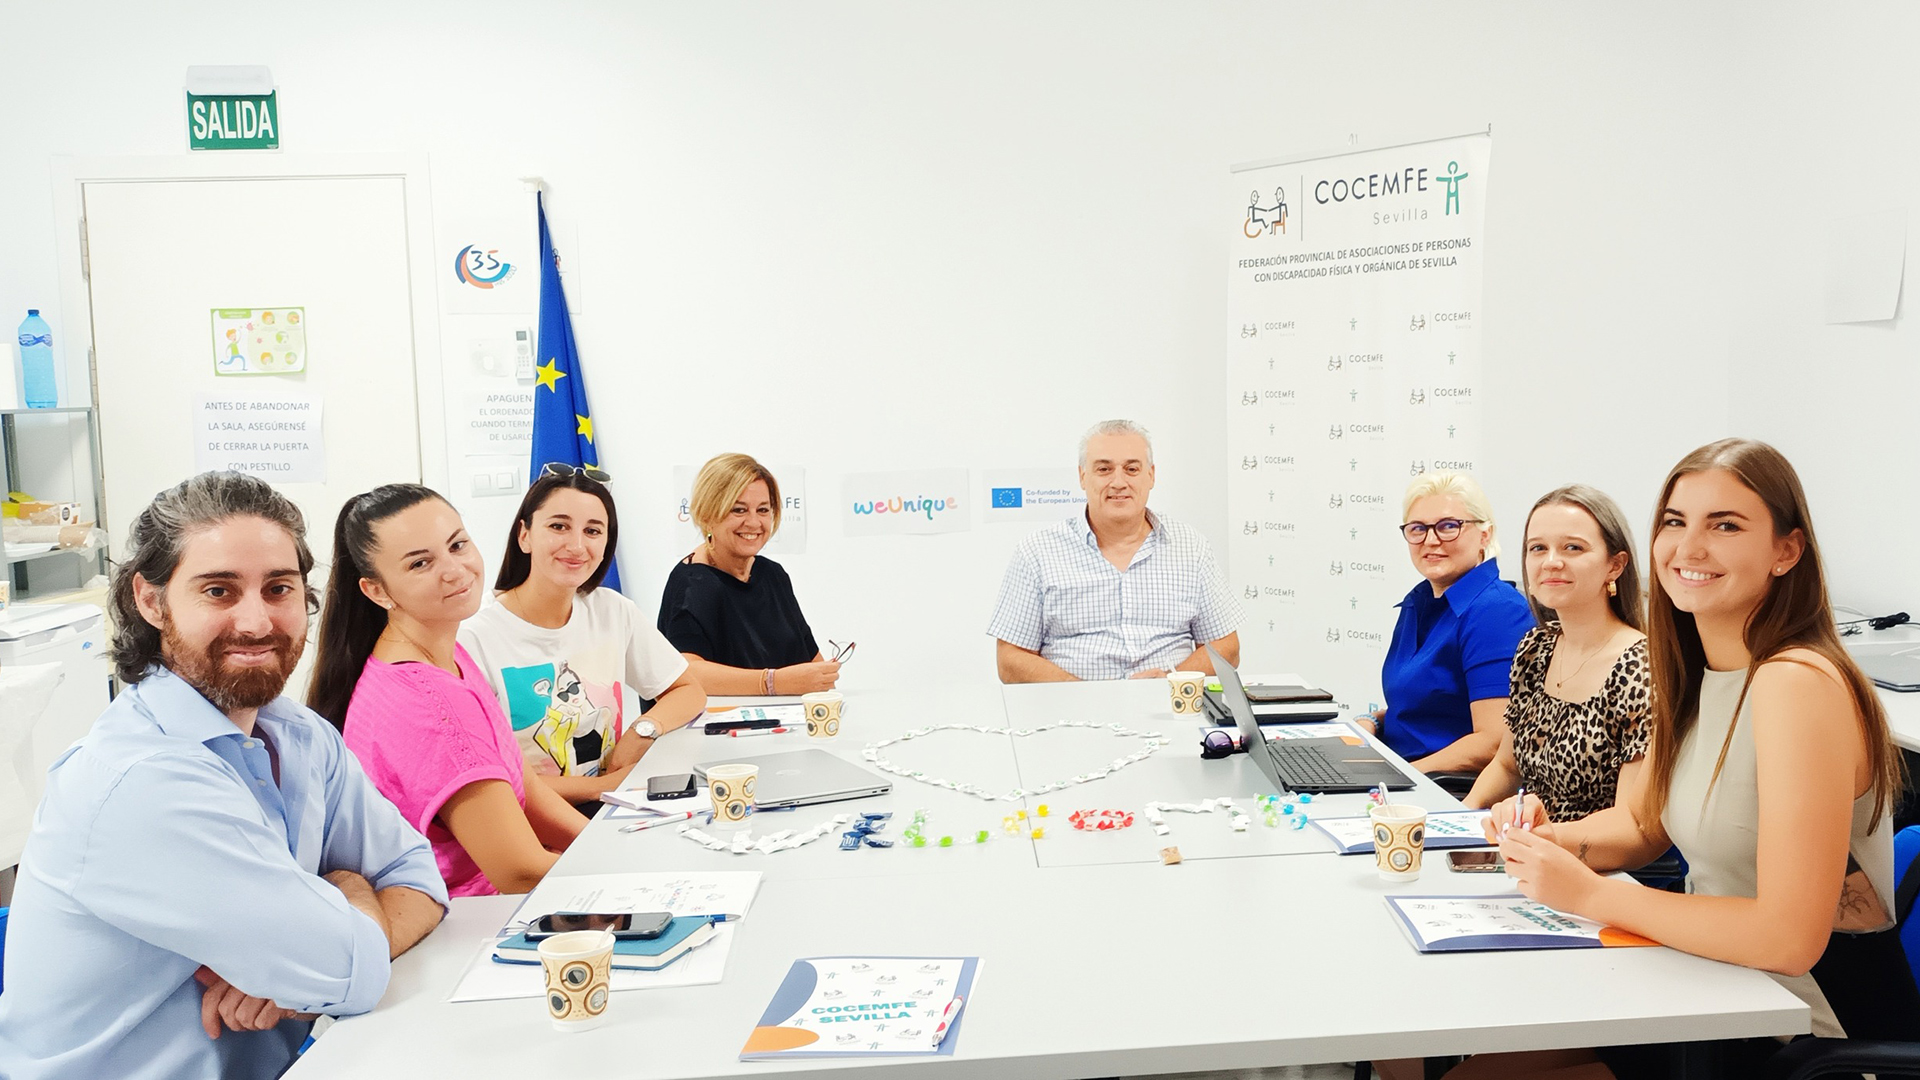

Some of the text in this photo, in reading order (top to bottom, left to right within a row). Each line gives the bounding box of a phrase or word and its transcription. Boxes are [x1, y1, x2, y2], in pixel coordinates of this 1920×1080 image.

[192, 100, 274, 140] SALIDA
[1314, 167, 1428, 204] COCEMFE
[1373, 208, 1428, 225] Sevilla
[1238, 238, 1472, 268] FEDERACIÓN PROVINCIAL DE ASOCIACIONES DE PERSONAS
[470, 249, 500, 270] 35
[1254, 256, 1457, 283] CON DISCAPACIDAD FÍSICA Y ORGÁNICA DE SEVILLA
[1434, 312, 1472, 322] COCEMFE
[1265, 320, 1295, 330] COCEMFE
[1349, 354, 1384, 363] COCEMFE
[1265, 390, 1295, 399] COCEMFE
[1434, 388, 1472, 397] COCEMFE
[486, 395, 532, 403] APAGUEN
[204, 402, 310, 411] ANTES DE ABANDONAR
[208, 422, 220, 431] LA
[222, 422, 246, 432] SALA,
[1350, 424, 1384, 433] COCEMFE
[208, 442, 309, 451] DE CERRAR LA PUERTA
[1264, 456, 1295, 465] COCEMFE
[1434, 460, 1473, 470] COCEMFE
[228, 462, 248, 471] CON
[1350, 494, 1384, 504] COCEMFE
[853, 495, 958, 520] weUnique
[1265, 522, 1295, 532] COCEMFE
[1350, 562, 1385, 573] COCEMFE
[1265, 586, 1295, 597] COCEMFE
[1347, 630, 1382, 642] COCEMFE
[811, 1000, 918, 1015] COCEMFE
[818, 1012, 912, 1024] SEVILLA
